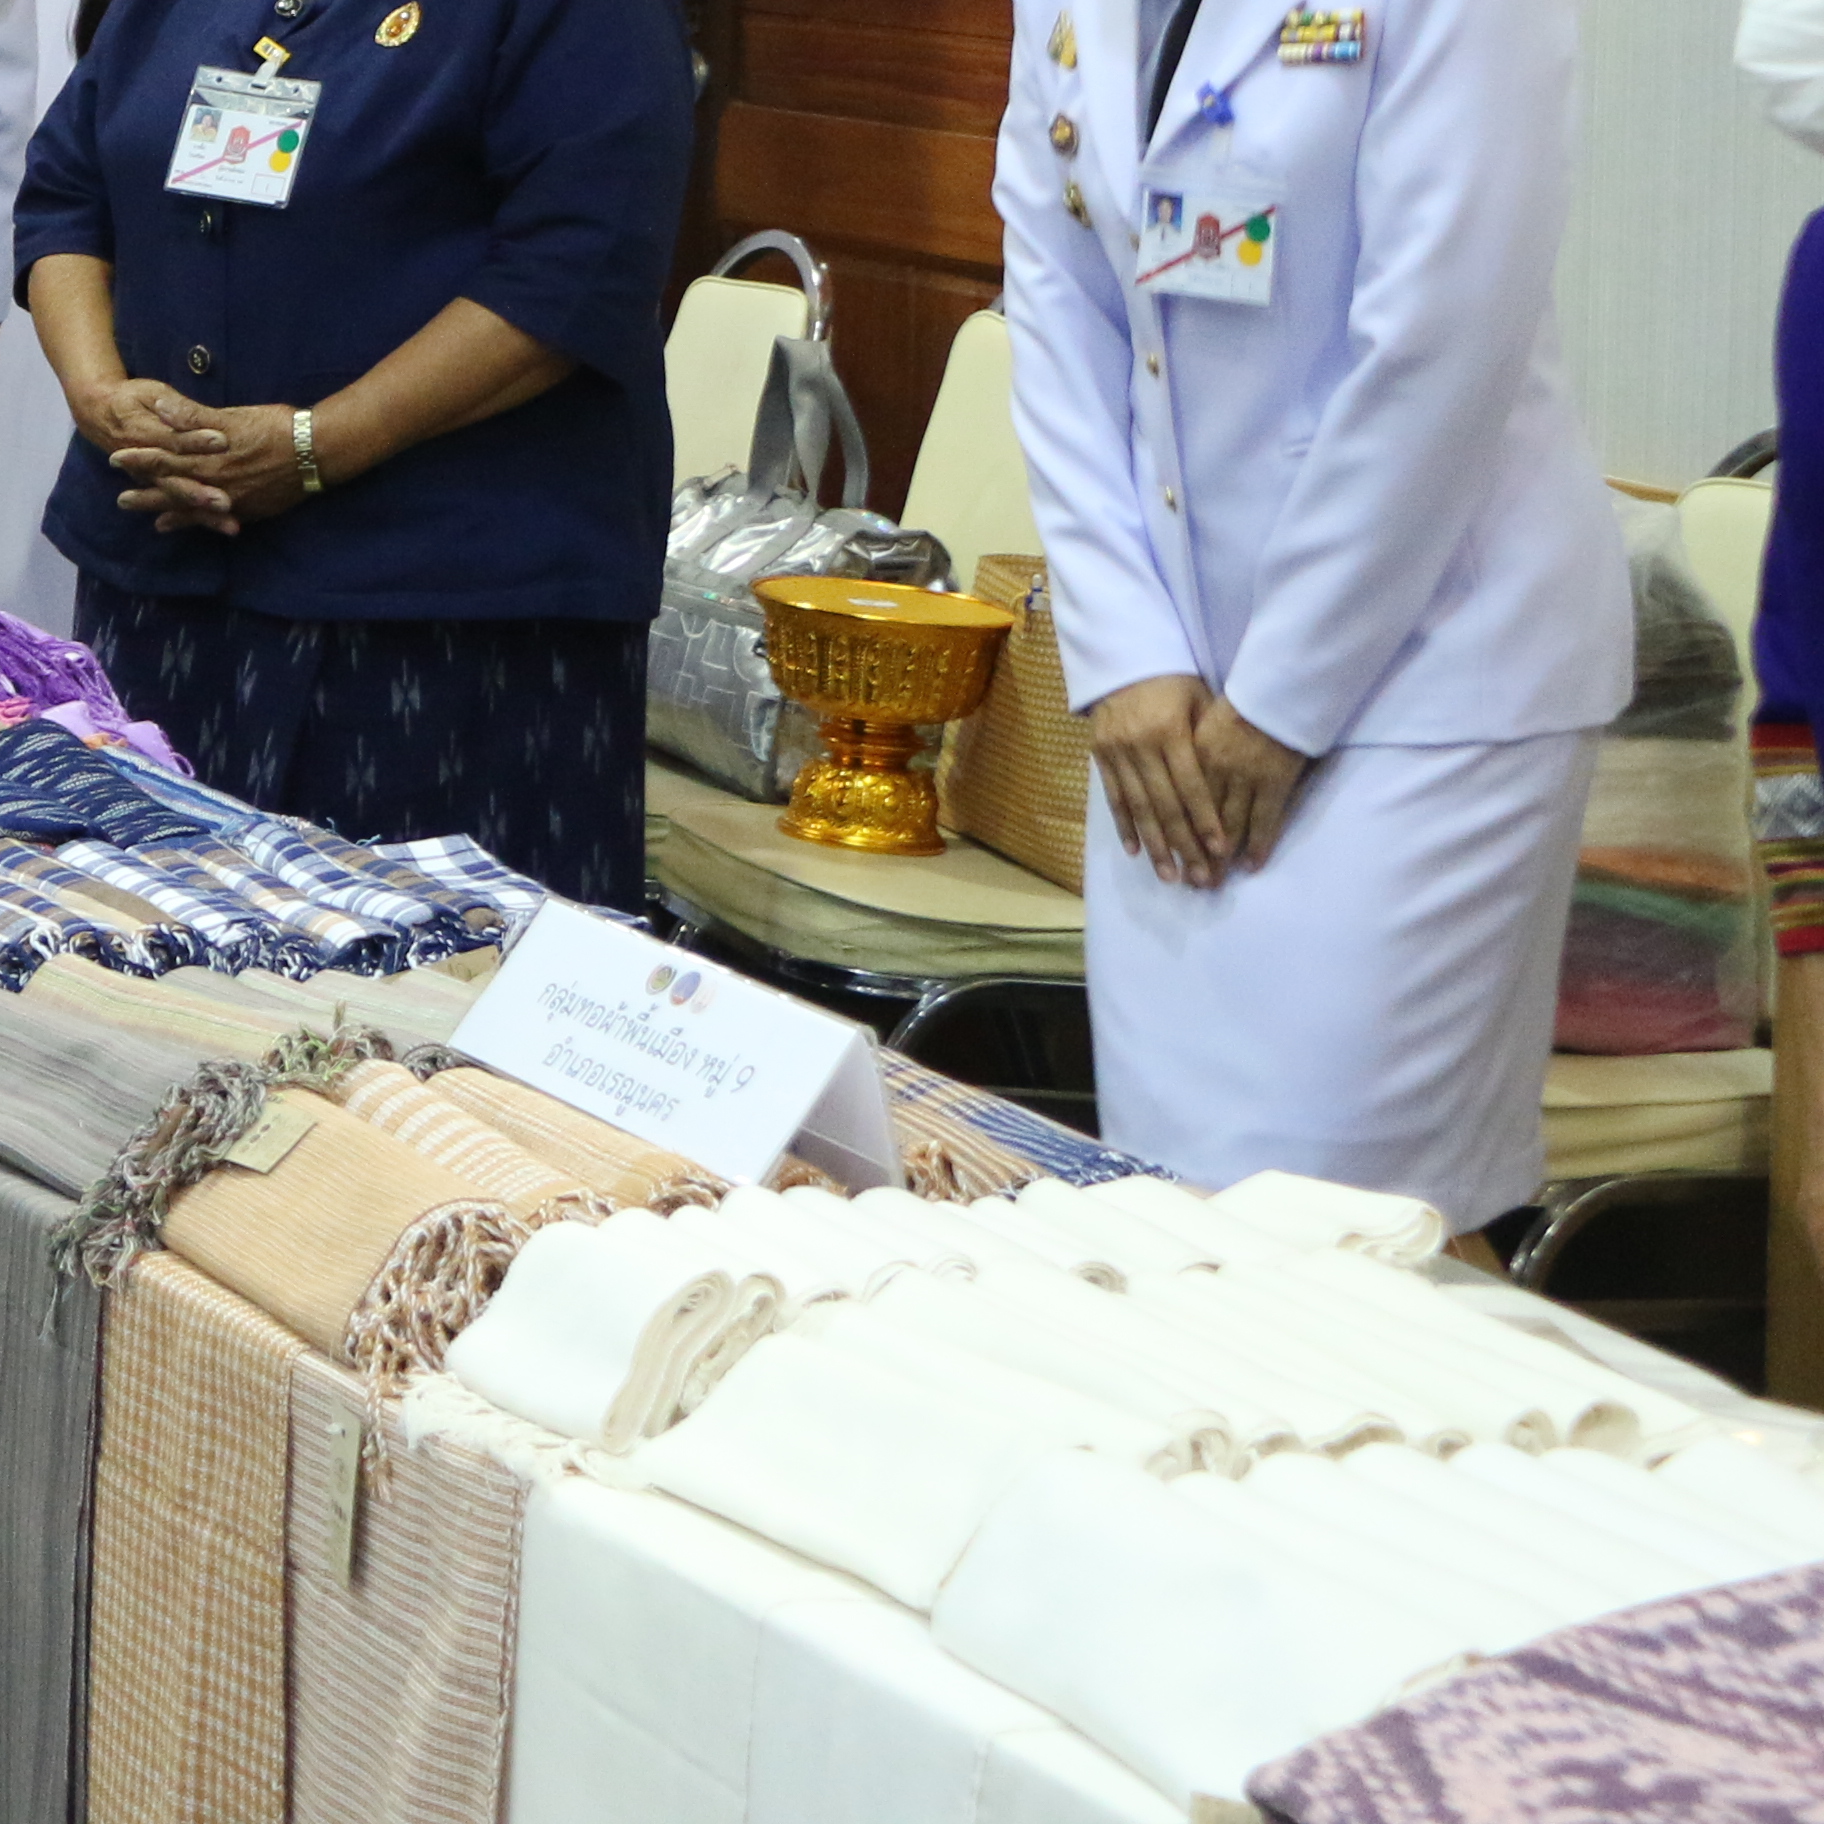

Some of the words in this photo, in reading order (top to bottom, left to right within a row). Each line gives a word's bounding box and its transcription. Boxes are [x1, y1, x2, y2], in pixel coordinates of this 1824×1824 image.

[537, 980, 699, 1071] กลุ่มทอผ้าพื้นเมือง
[695, 1053, 740, 1099] หมู่
[542, 1035, 681, 1122] อำเภอเรณูนคร
